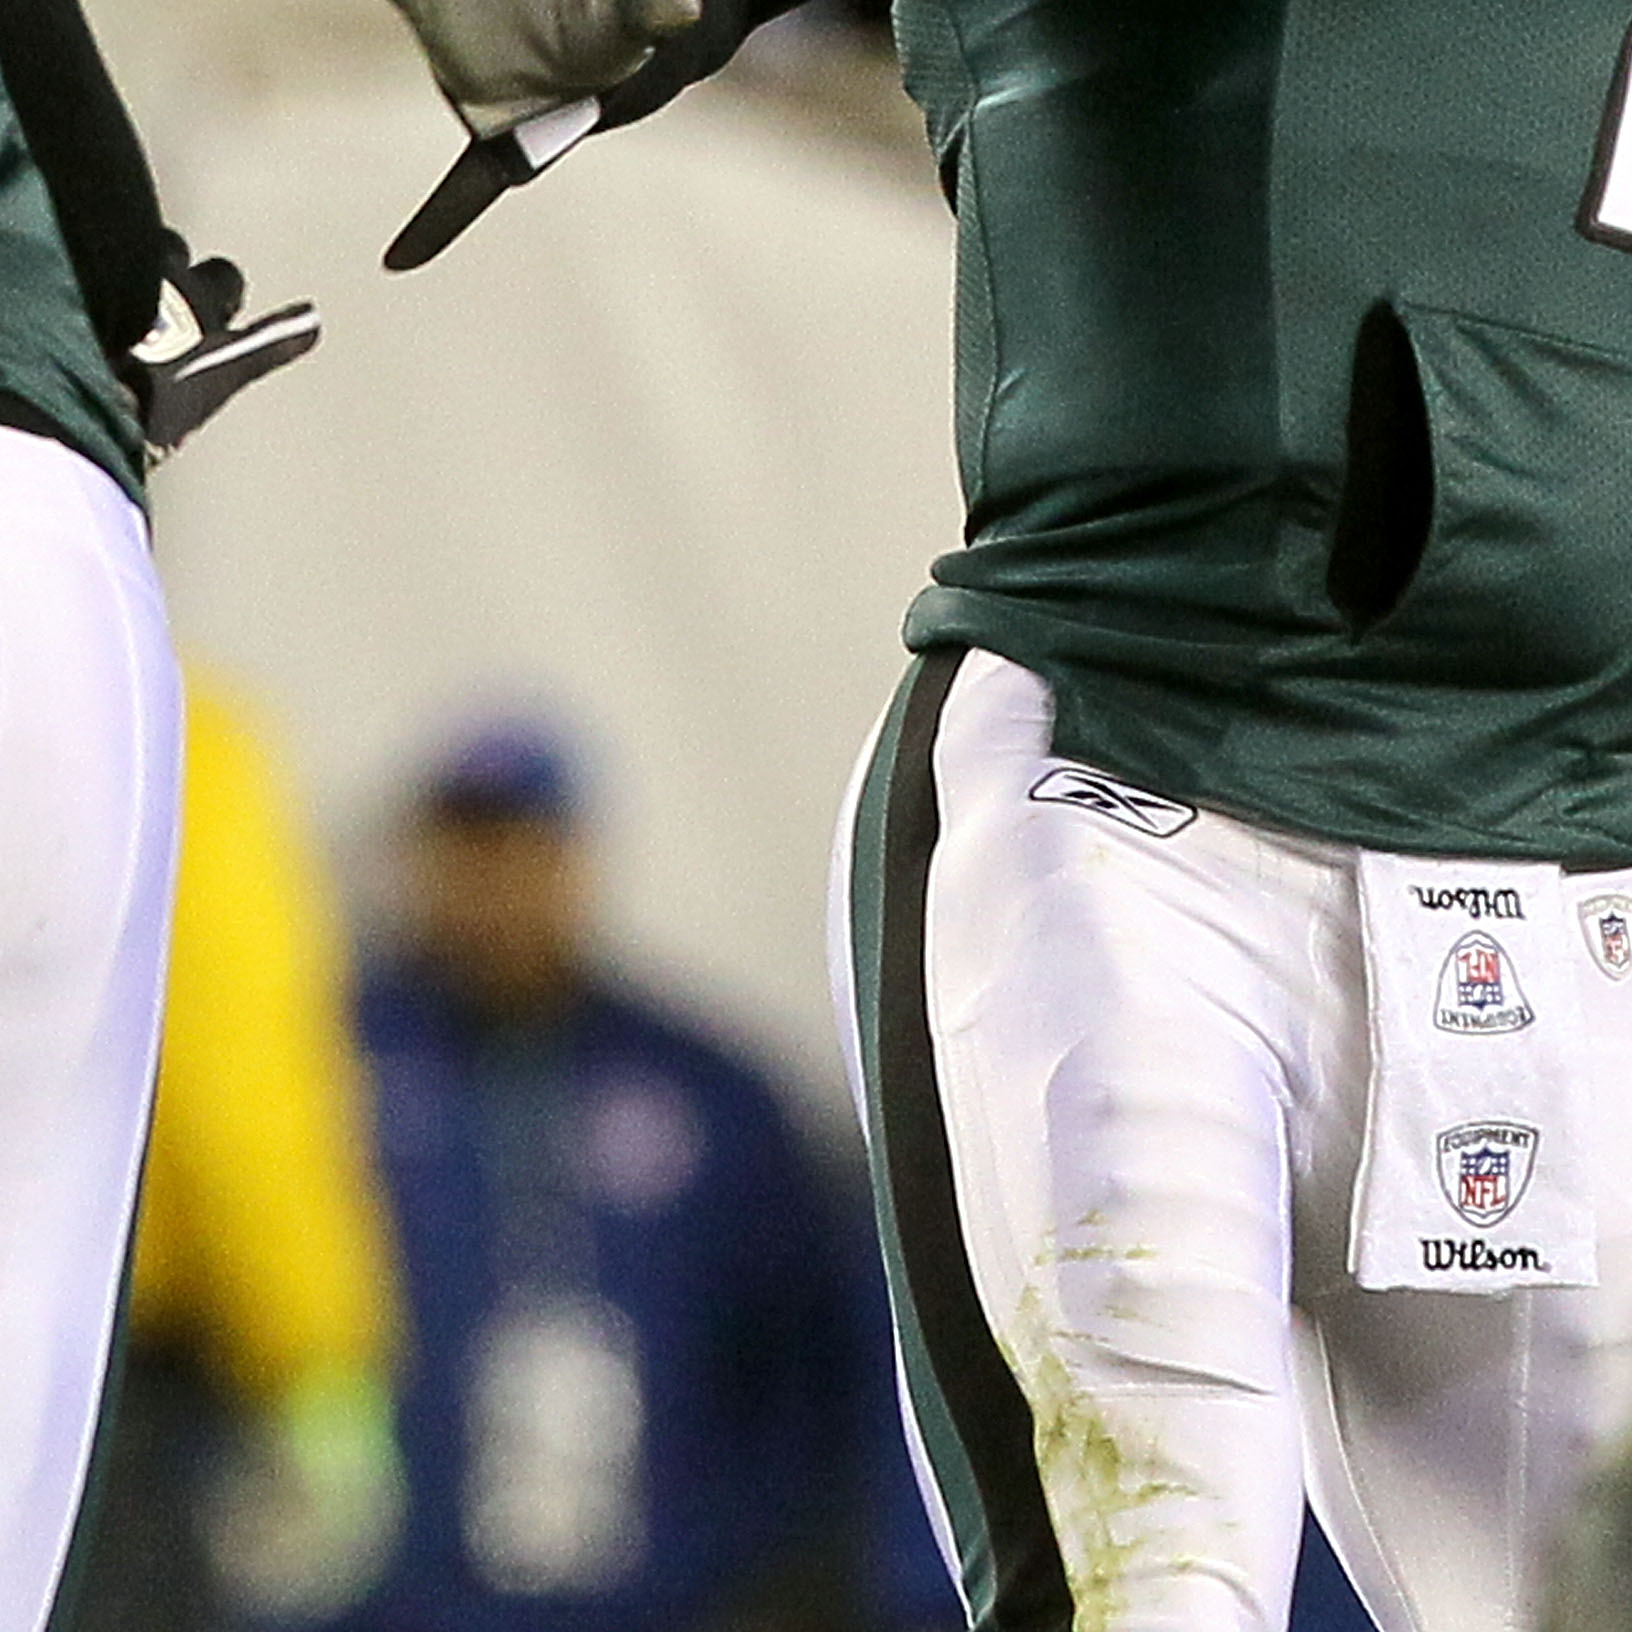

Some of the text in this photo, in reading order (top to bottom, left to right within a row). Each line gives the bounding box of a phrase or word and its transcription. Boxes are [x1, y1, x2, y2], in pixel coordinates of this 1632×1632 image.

[1408, 883, 1527, 921] Wilson
[1460, 1174, 1507, 1209] NFL
[1418, 1237, 1552, 1273] Wilson
